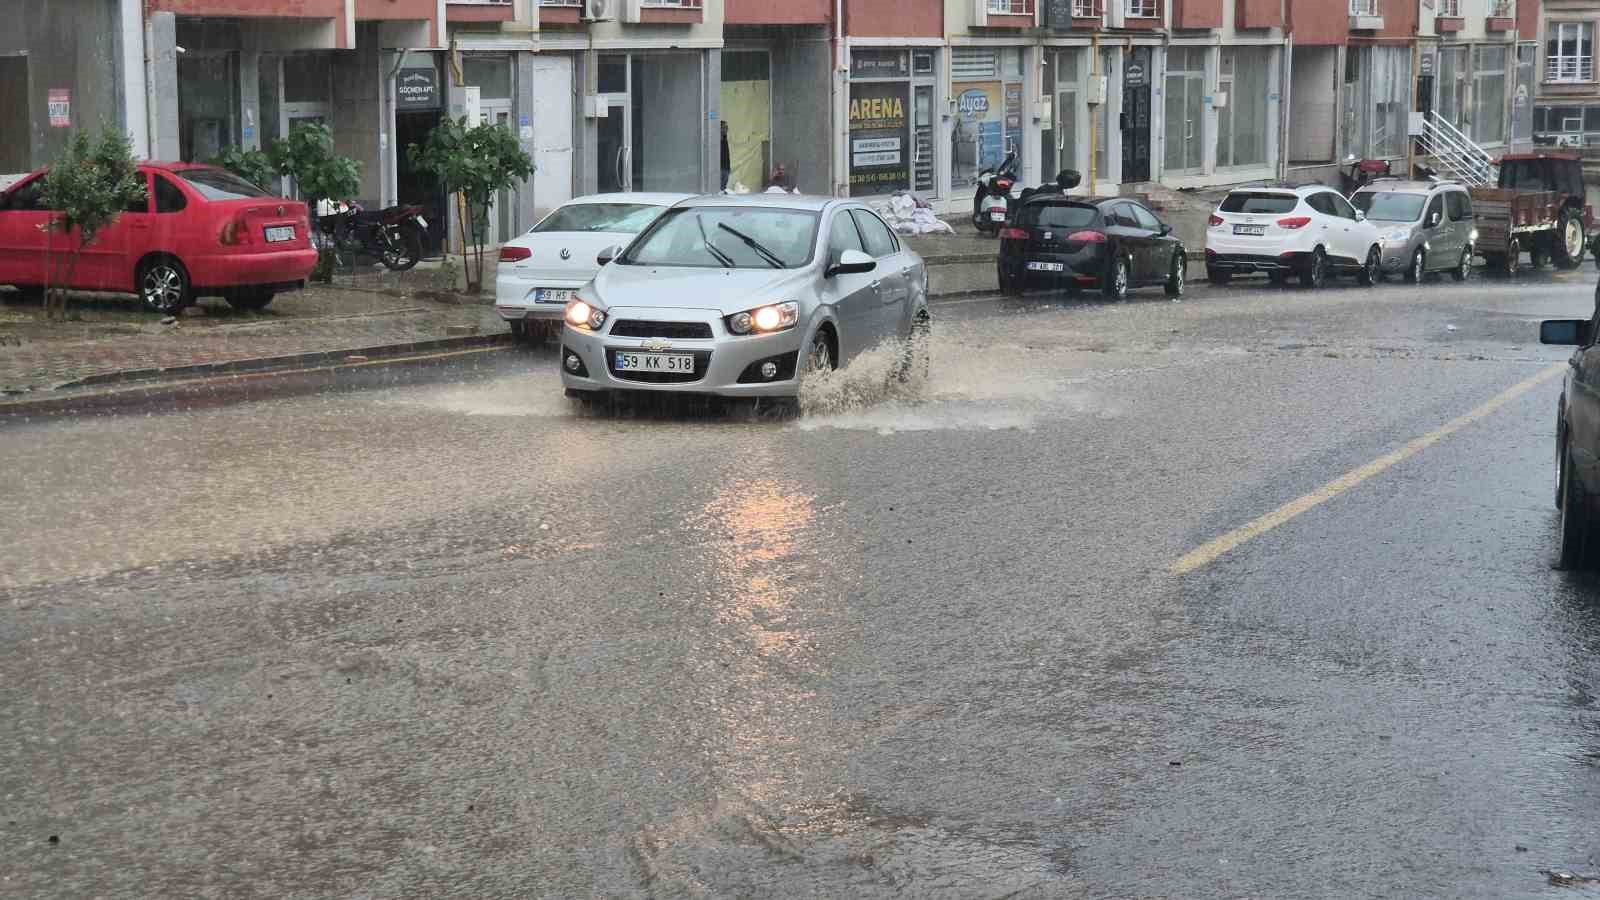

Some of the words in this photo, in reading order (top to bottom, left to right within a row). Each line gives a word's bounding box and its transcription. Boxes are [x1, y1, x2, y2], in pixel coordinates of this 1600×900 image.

[849, 97, 904, 120] ARENA
[959, 93, 988, 117] Ayaz
[623, 355, 638, 368] 59
[646, 356, 661, 369] KK
[668, 357, 691, 370] 518
